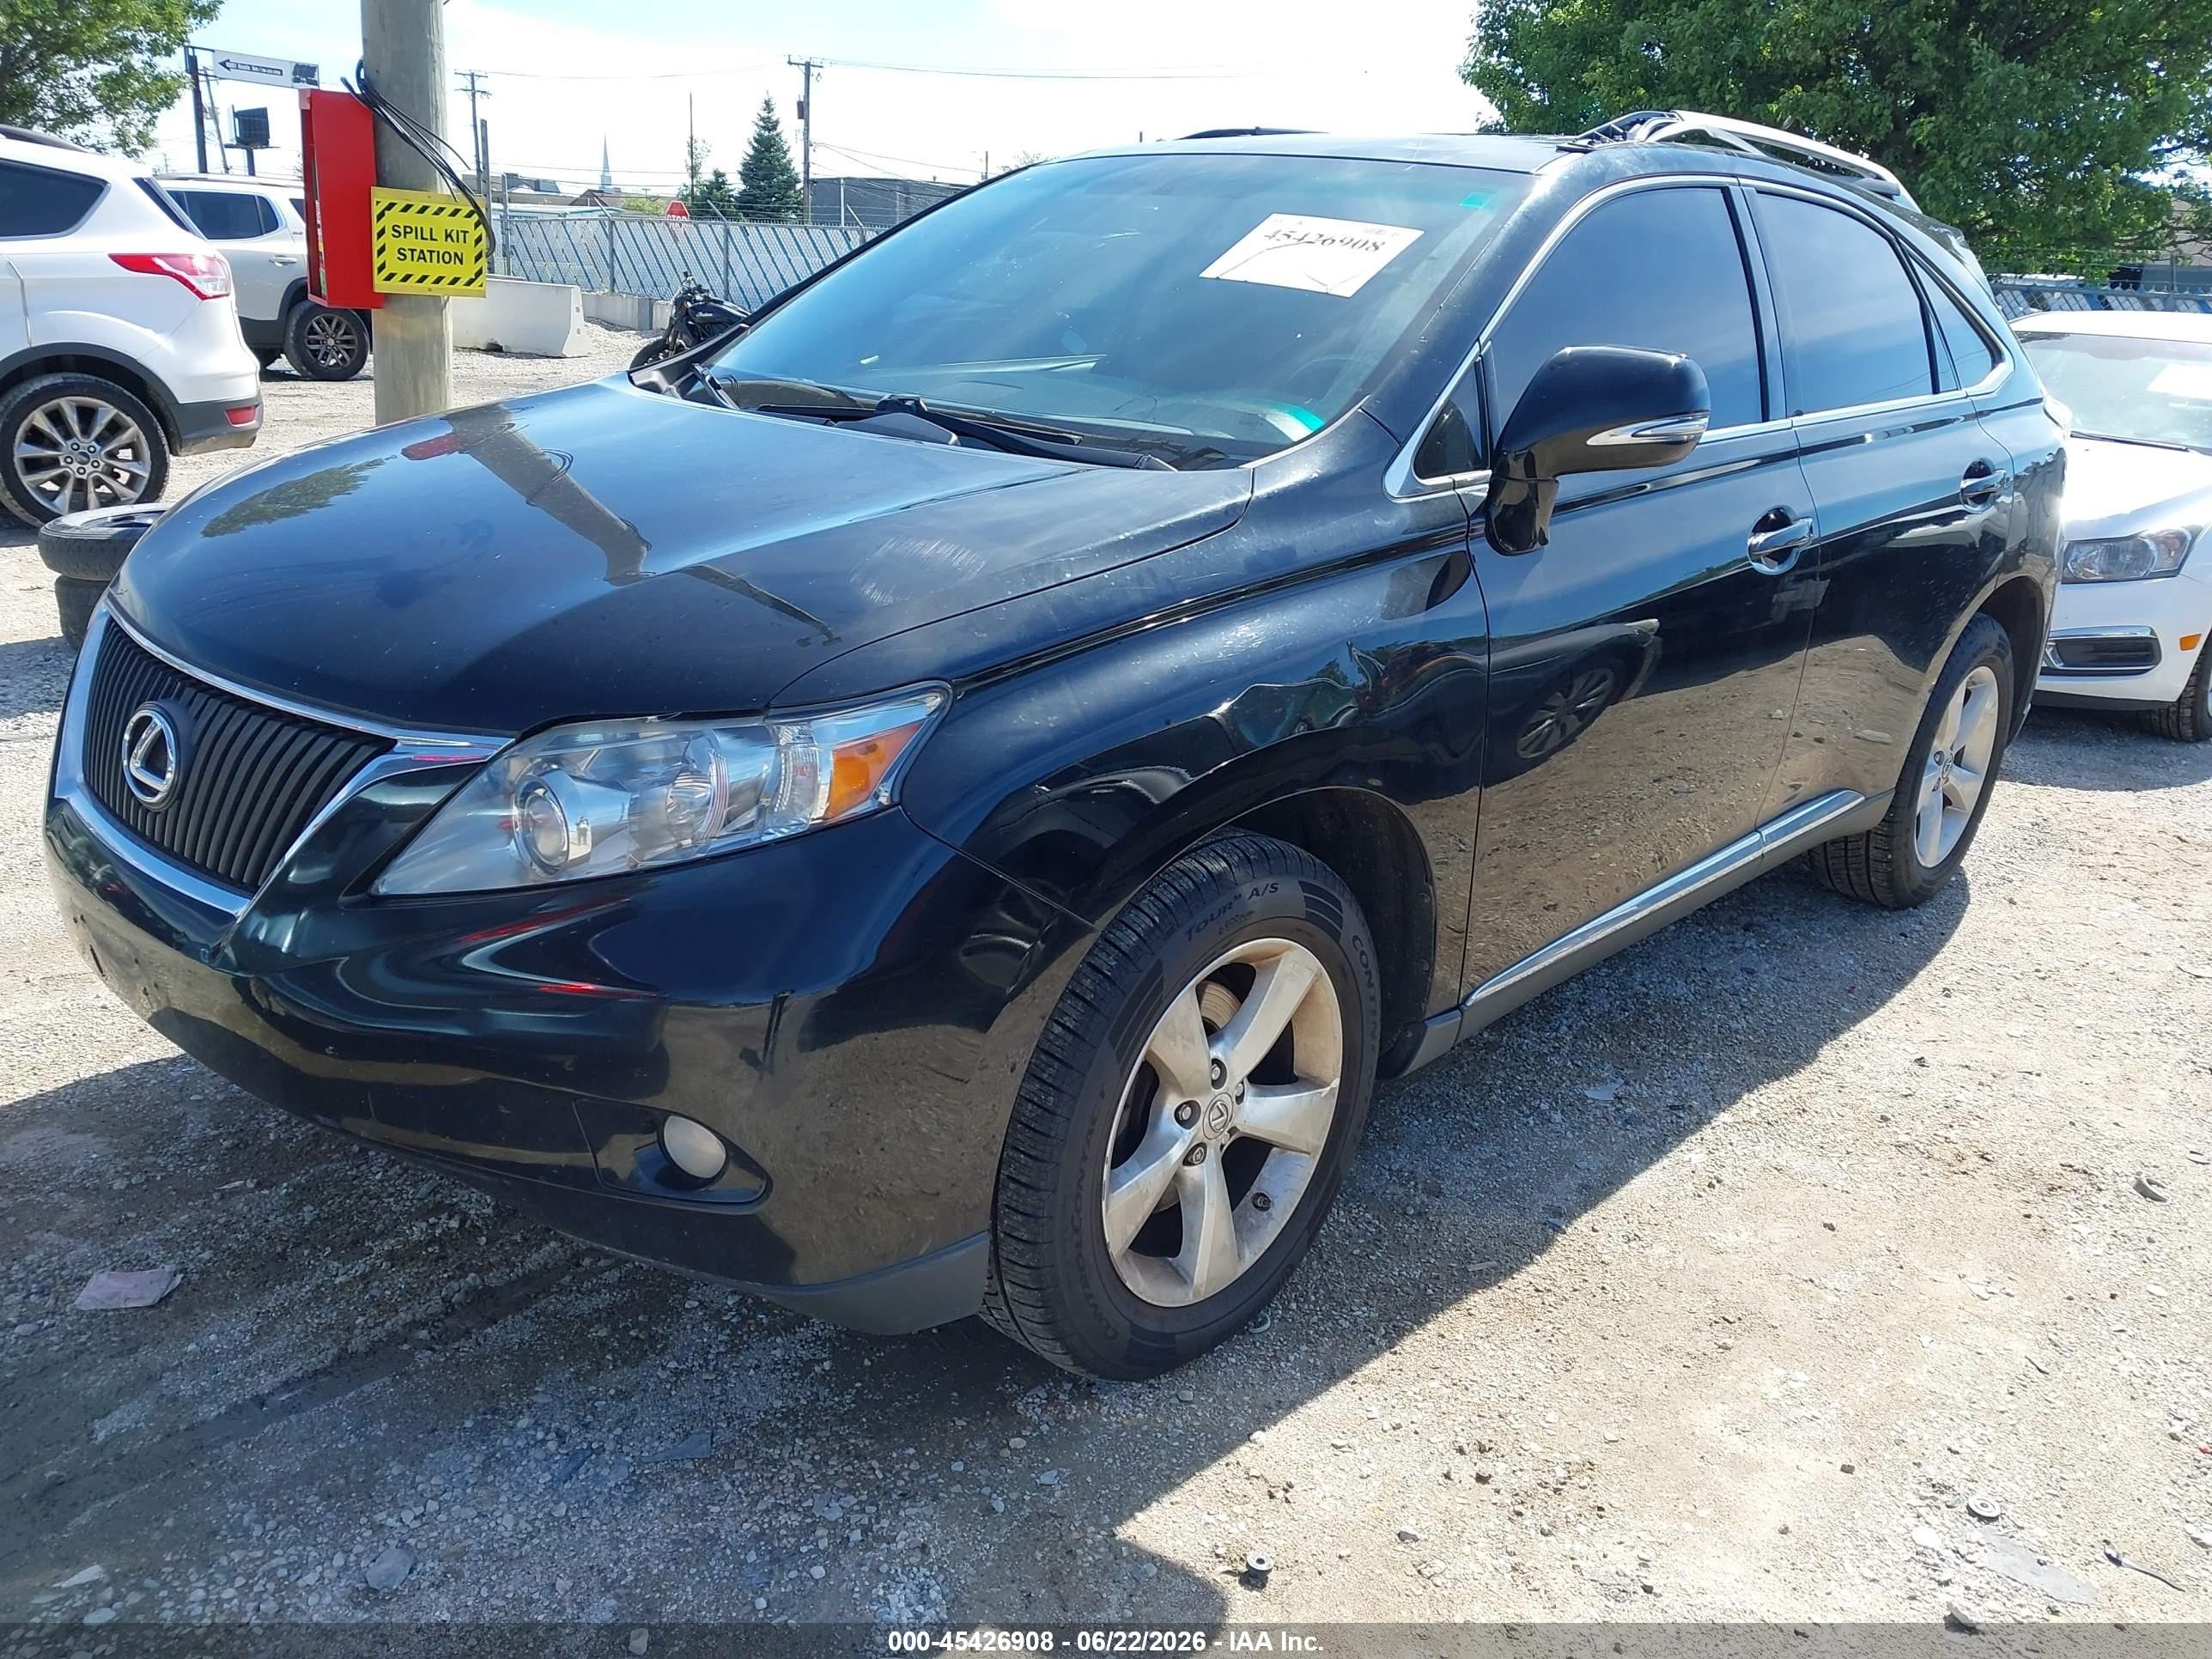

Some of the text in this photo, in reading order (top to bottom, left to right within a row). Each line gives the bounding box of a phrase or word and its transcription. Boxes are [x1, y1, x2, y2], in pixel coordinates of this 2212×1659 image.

[392, 224, 469, 244] SPILL KIT
[1264, 228, 1386, 252] 45426908
[397, 247, 464, 265] STATION
[1248, 883, 1279, 900] A/S
